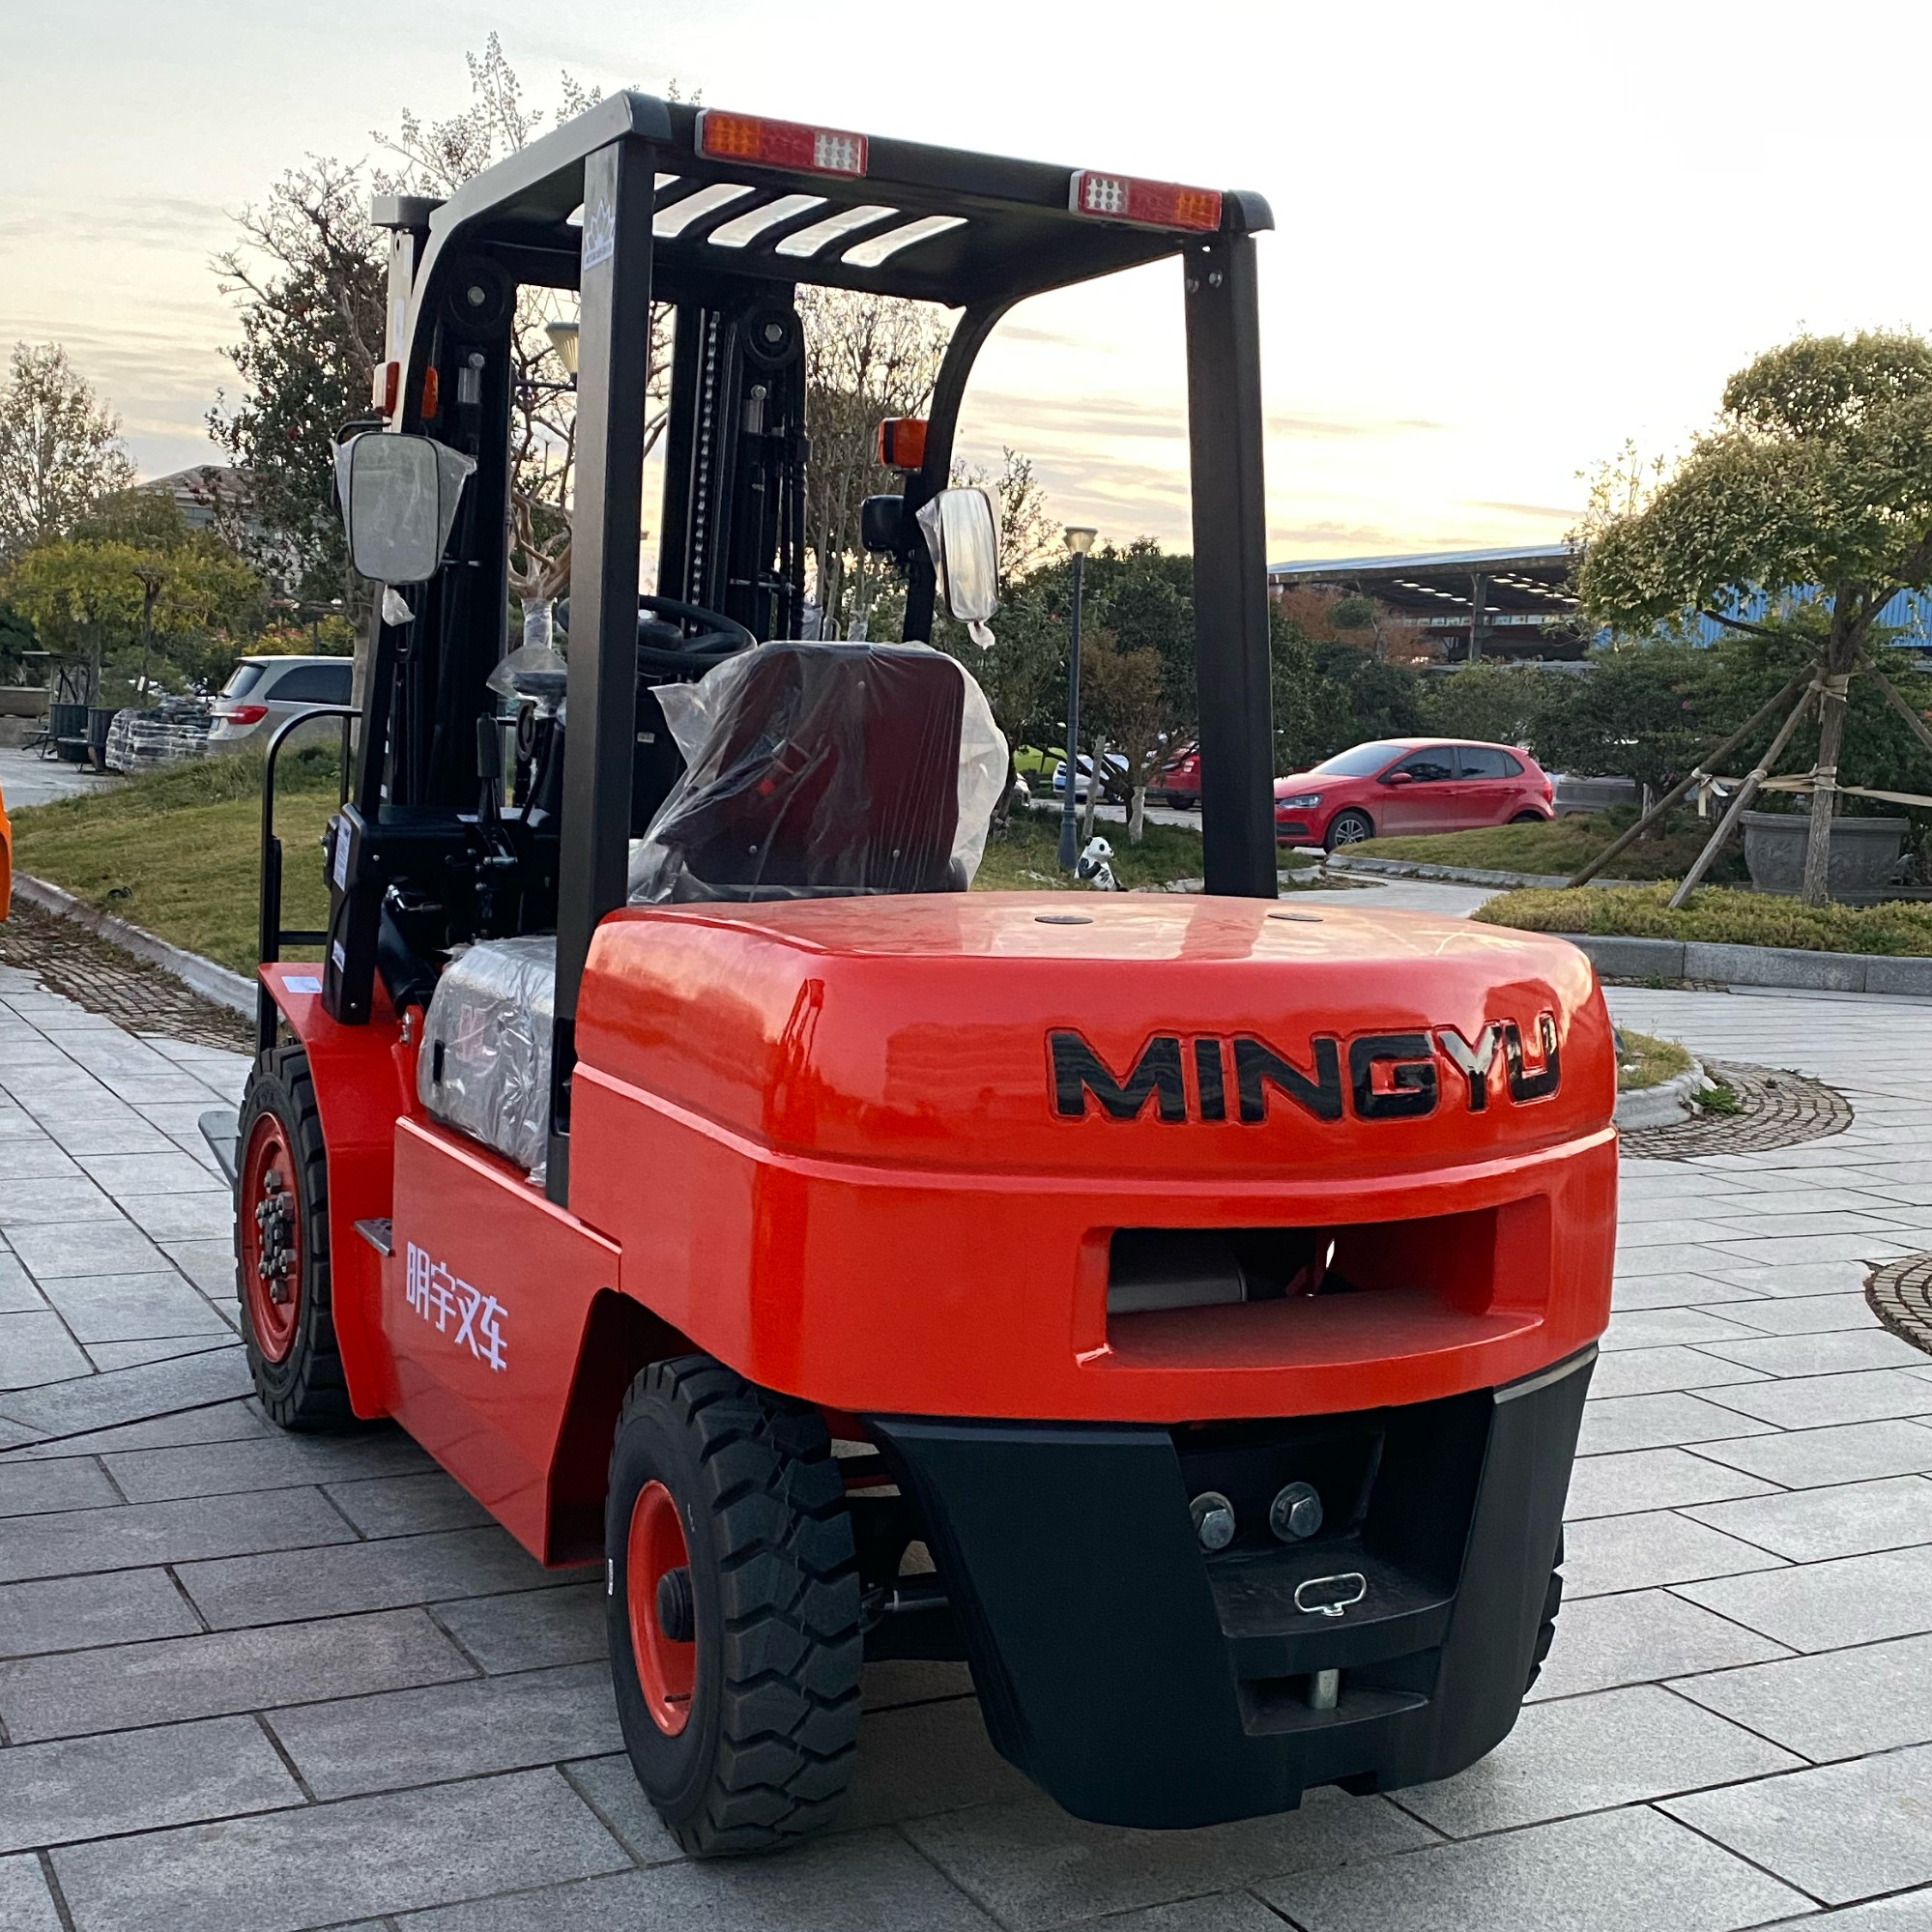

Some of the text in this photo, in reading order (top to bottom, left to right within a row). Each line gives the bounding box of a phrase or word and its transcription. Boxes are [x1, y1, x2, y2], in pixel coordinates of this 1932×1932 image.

[1047, 1013, 1561, 1121] MINGYU
[406, 1241, 508, 1370] 明宇叉车
